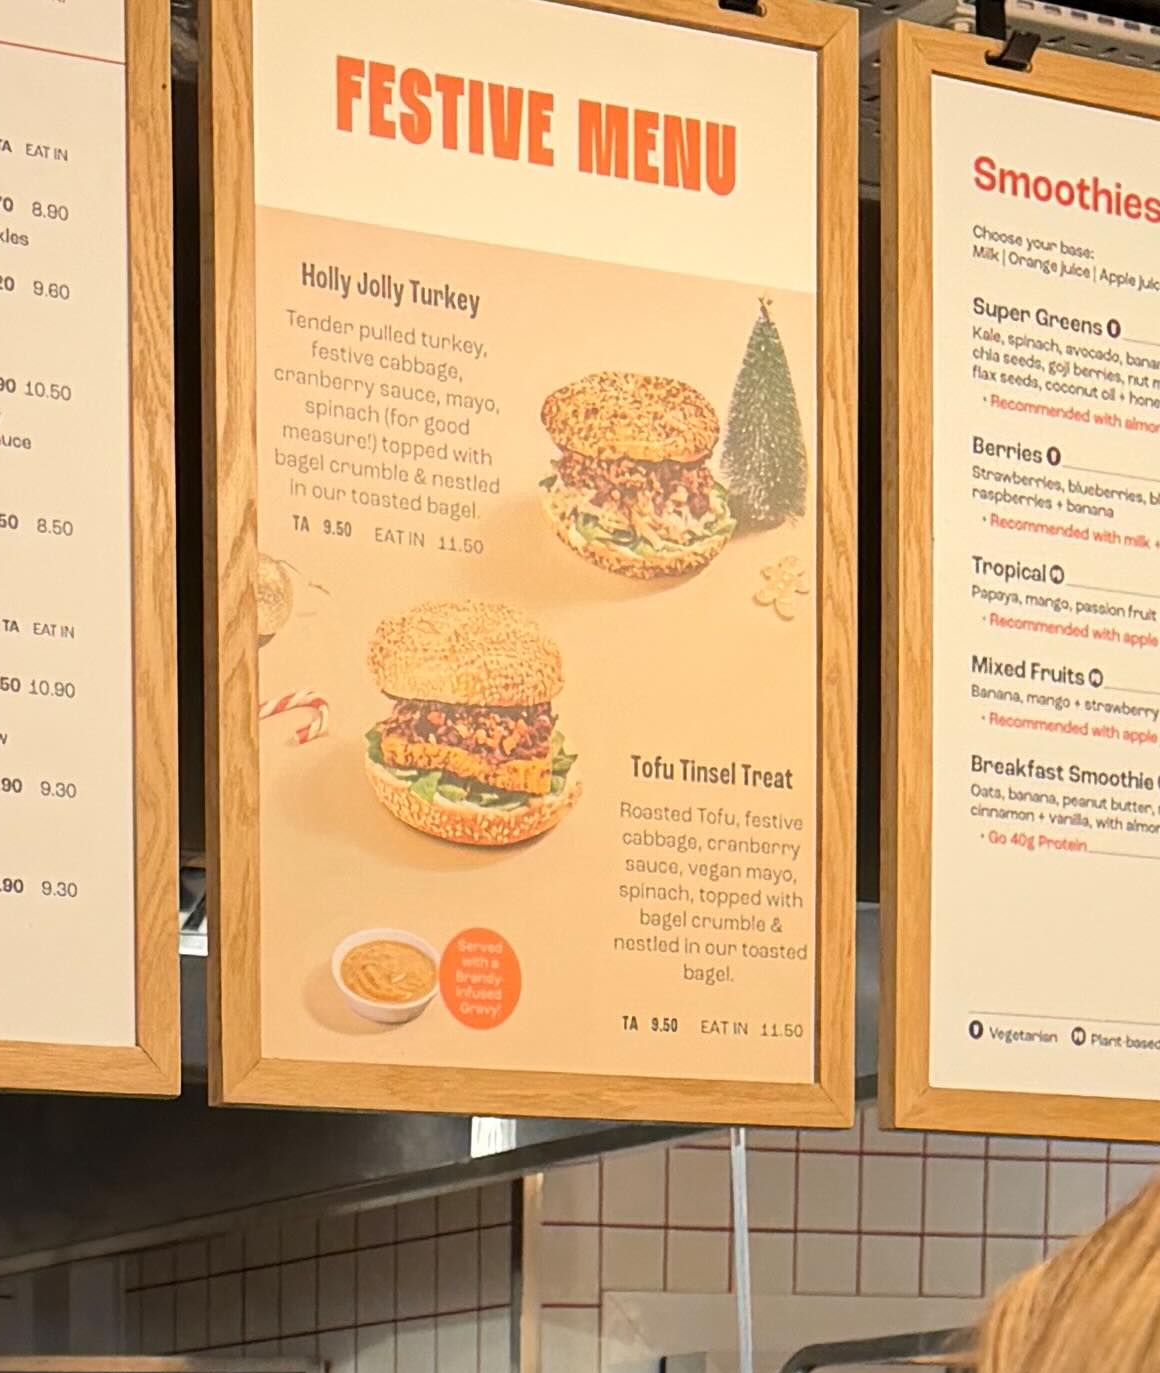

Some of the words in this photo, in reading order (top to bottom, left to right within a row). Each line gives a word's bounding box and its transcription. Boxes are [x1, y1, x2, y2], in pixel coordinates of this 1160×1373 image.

[336, 54, 554, 166] FESTIVE
[578, 99, 736, 196] MENU
[32, 201, 68, 221] 8.90
[972, 224, 1022, 246] Choose
[1026, 238, 1057, 251] your
[1060, 240, 1094, 260] base:
[33, 280, 70, 300] 9.60
[302, 262, 351, 300] Holly
[358, 272, 404, 308] Jolly
[409, 280, 480, 319] Turkey
[973, 297, 1030, 324] Super
[1036, 308, 1102, 336] Greens
[286, 308, 354, 334] Tender
[360, 324, 416, 345] pulled
[421, 332, 487, 360] turkey,
[24, 380, 72, 401] 10.50
[973, 436, 1042, 464] Berries
[37, 518, 74, 536] 8.50
[292, 514, 310, 532] TA
[323, 519, 352, 537] 9.50
[375, 528, 404, 544] EAT
[409, 532, 424, 548] IN
[438, 536, 484, 554] 11.50
[972, 555, 1046, 582] Tropical
[972, 654, 1026, 678] Mixed
[1031, 662, 1084, 686] Fruits
[29, 680, 75, 698] 10.90
[630, 754, 674, 780] Tofu
[680, 759, 736, 784] Tinsel
[742, 764, 792, 790] Treat
[972, 754, 1064, 781] Breakfast
[1069, 765, 1154, 790] Smoothie
[40, 780, 76, 798] 9.30
[42, 880, 78, 898] 9.30
[622, 1016, 638, 1030] TA
[652, 1017, 678, 1032] 9.50
[701, 1020, 729, 1034] EAT
[733, 1022, 748, 1036] IN
[760, 1023, 803, 1038] 11.50
